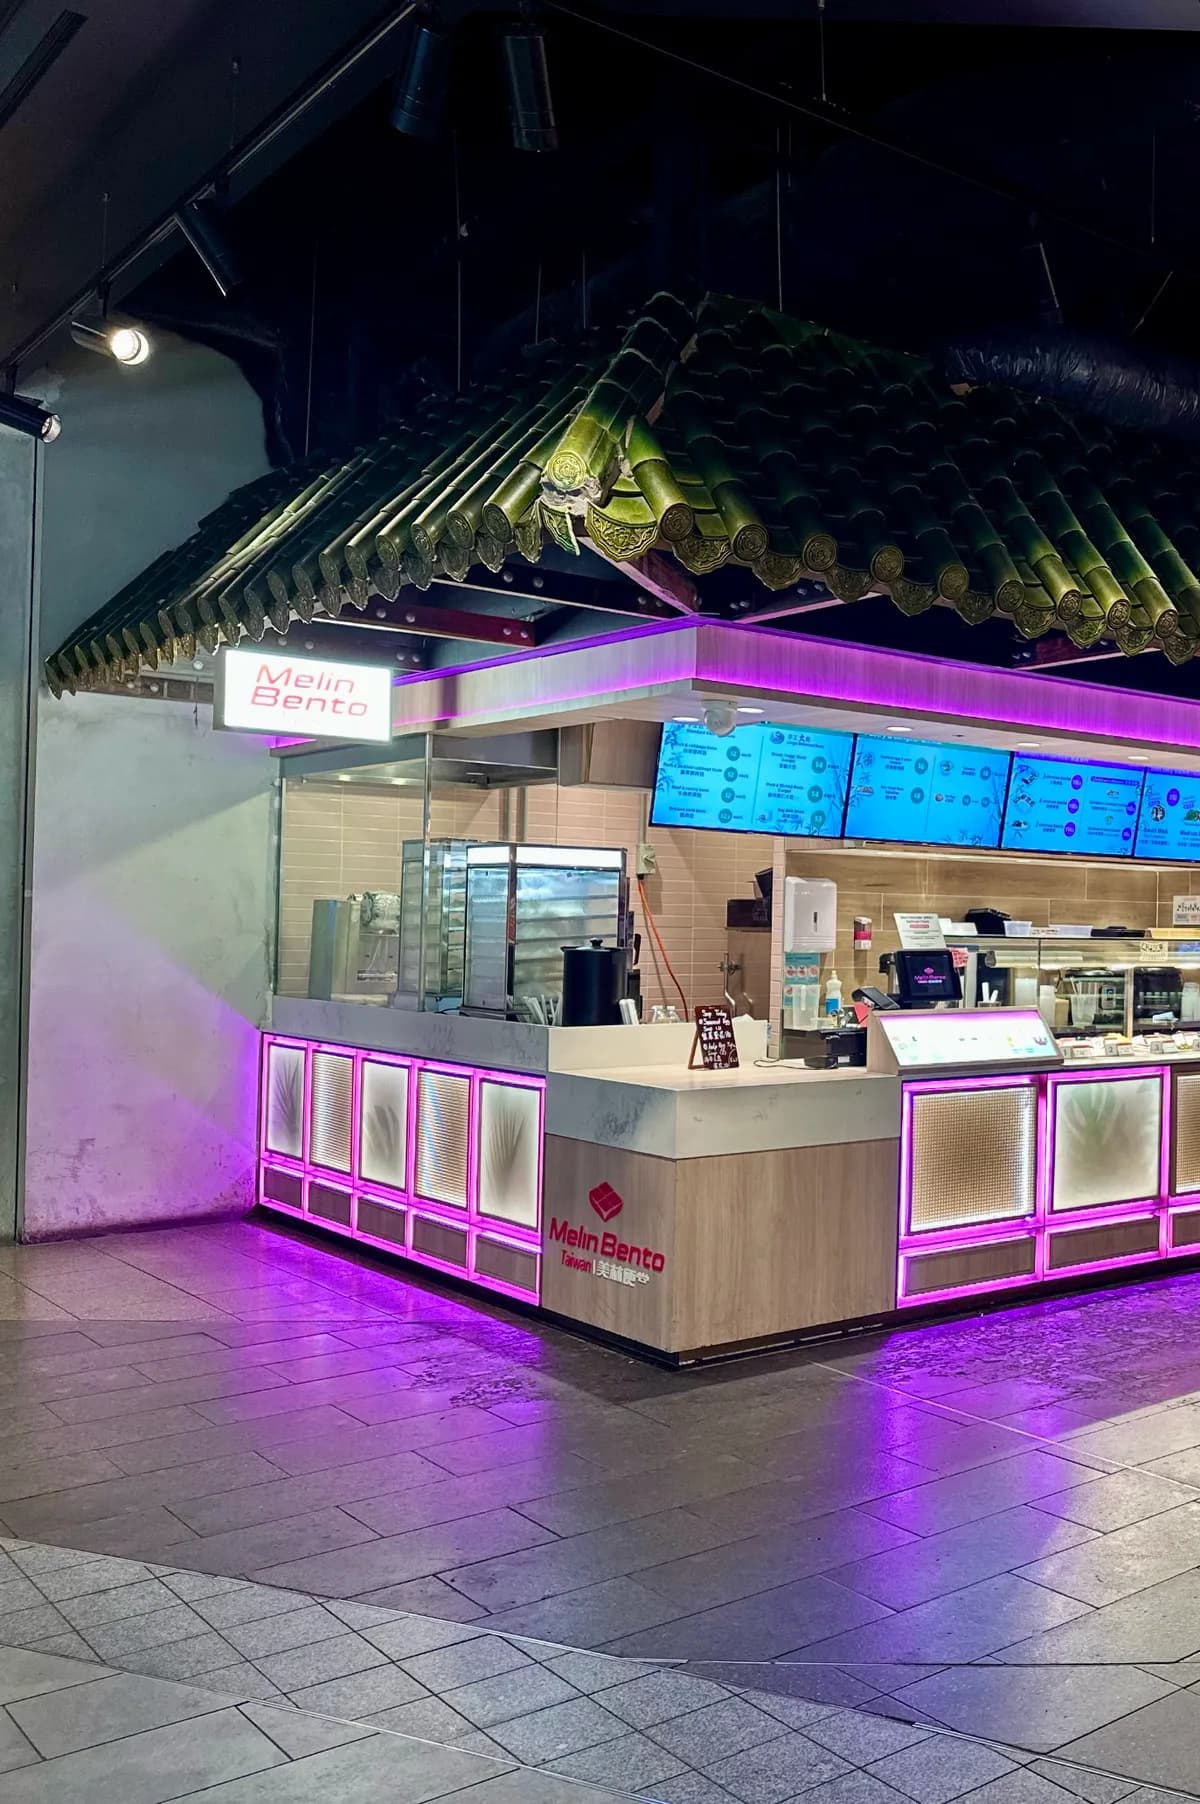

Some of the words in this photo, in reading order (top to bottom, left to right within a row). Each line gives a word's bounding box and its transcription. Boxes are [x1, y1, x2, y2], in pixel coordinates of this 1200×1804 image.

[256, 663, 355, 694] Melin
[251, 686, 368, 717] Bento
[549, 1217, 599, 1253] Melin
[600, 1232, 665, 1273] Bento
[561, 1249, 592, 1273] Taiwan
